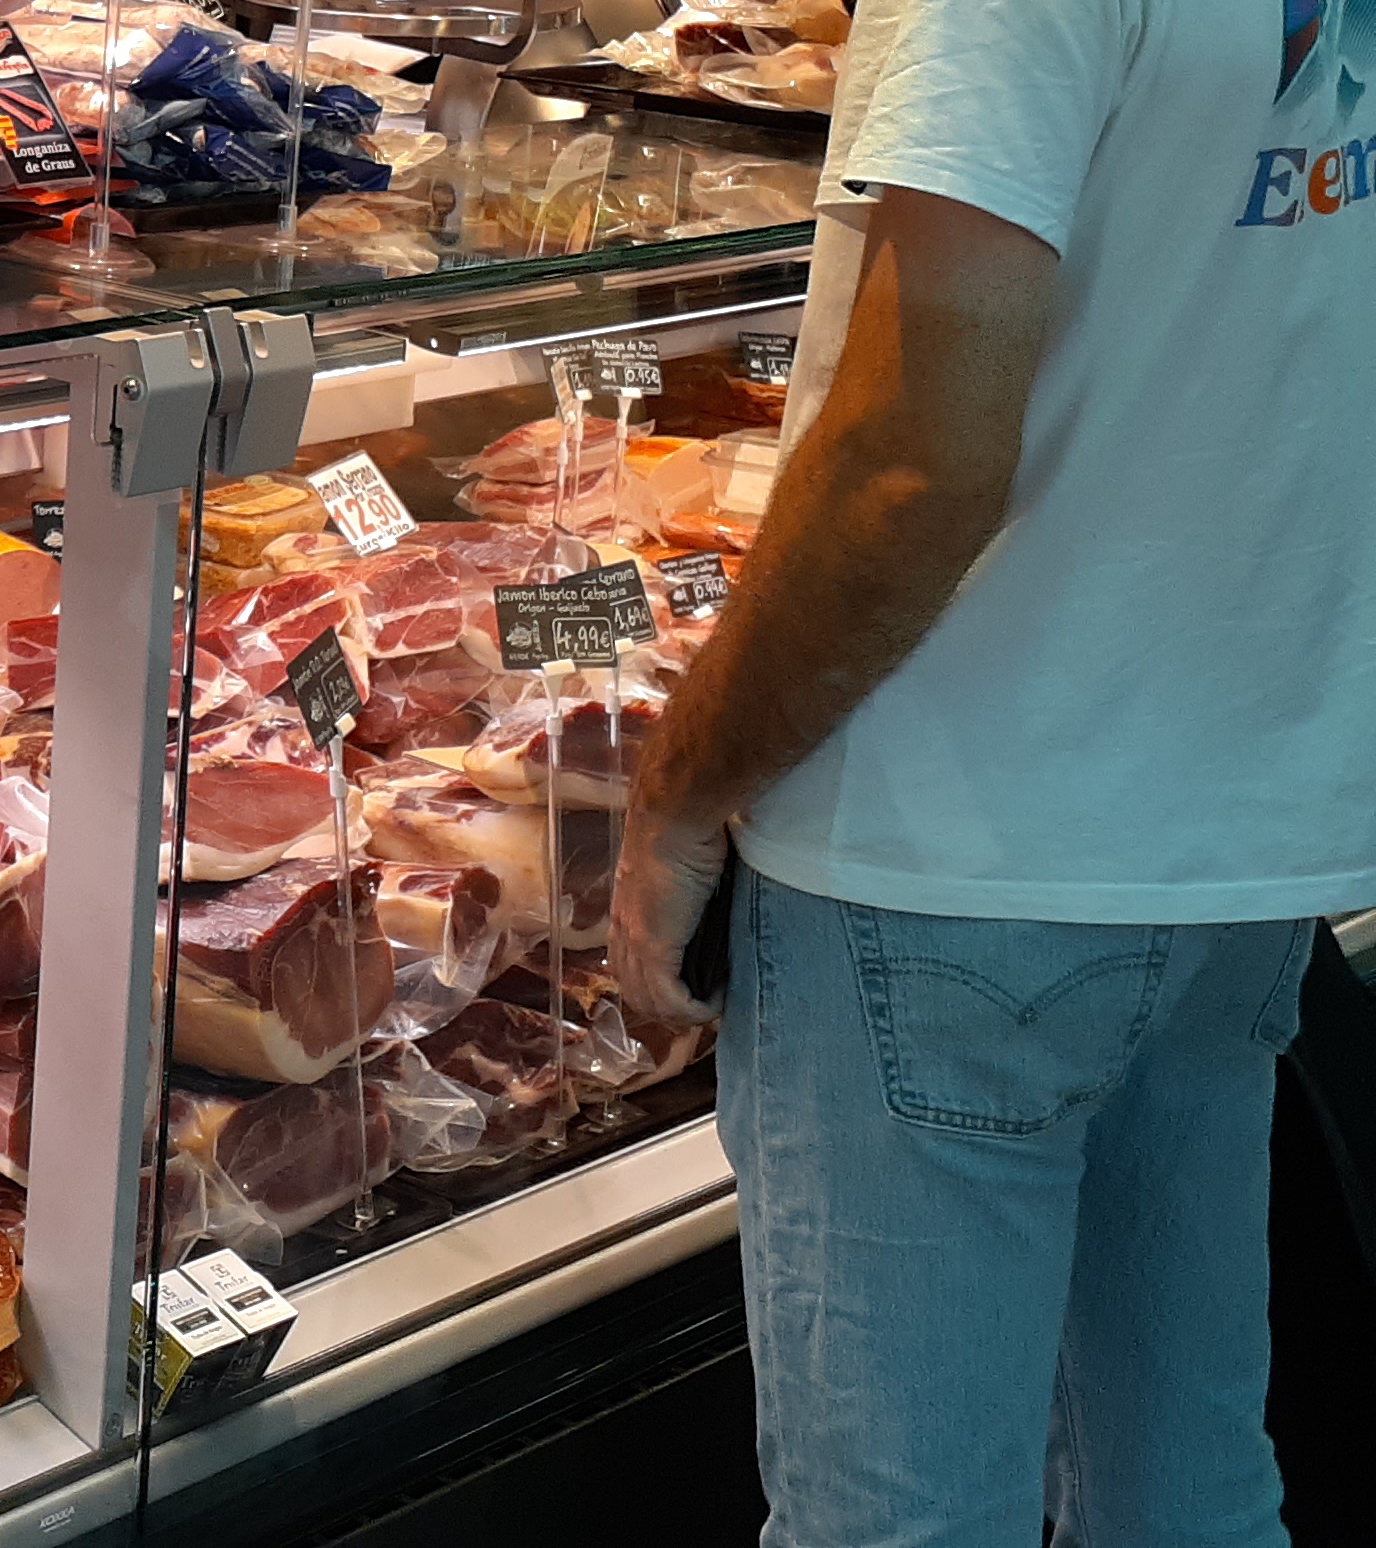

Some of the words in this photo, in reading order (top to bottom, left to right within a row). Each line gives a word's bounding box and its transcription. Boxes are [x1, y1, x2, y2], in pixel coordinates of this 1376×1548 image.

[13, 141, 72, 159] Longaniza
[25, 161, 41, 174] de
[42, 158, 76, 172] Graus
[498, 588, 536, 604] Jamon
[538, 587, 578, 602] Iberico
[580, 586, 609, 601] Cebo
[556, 621, 612, 653] 4,99€
